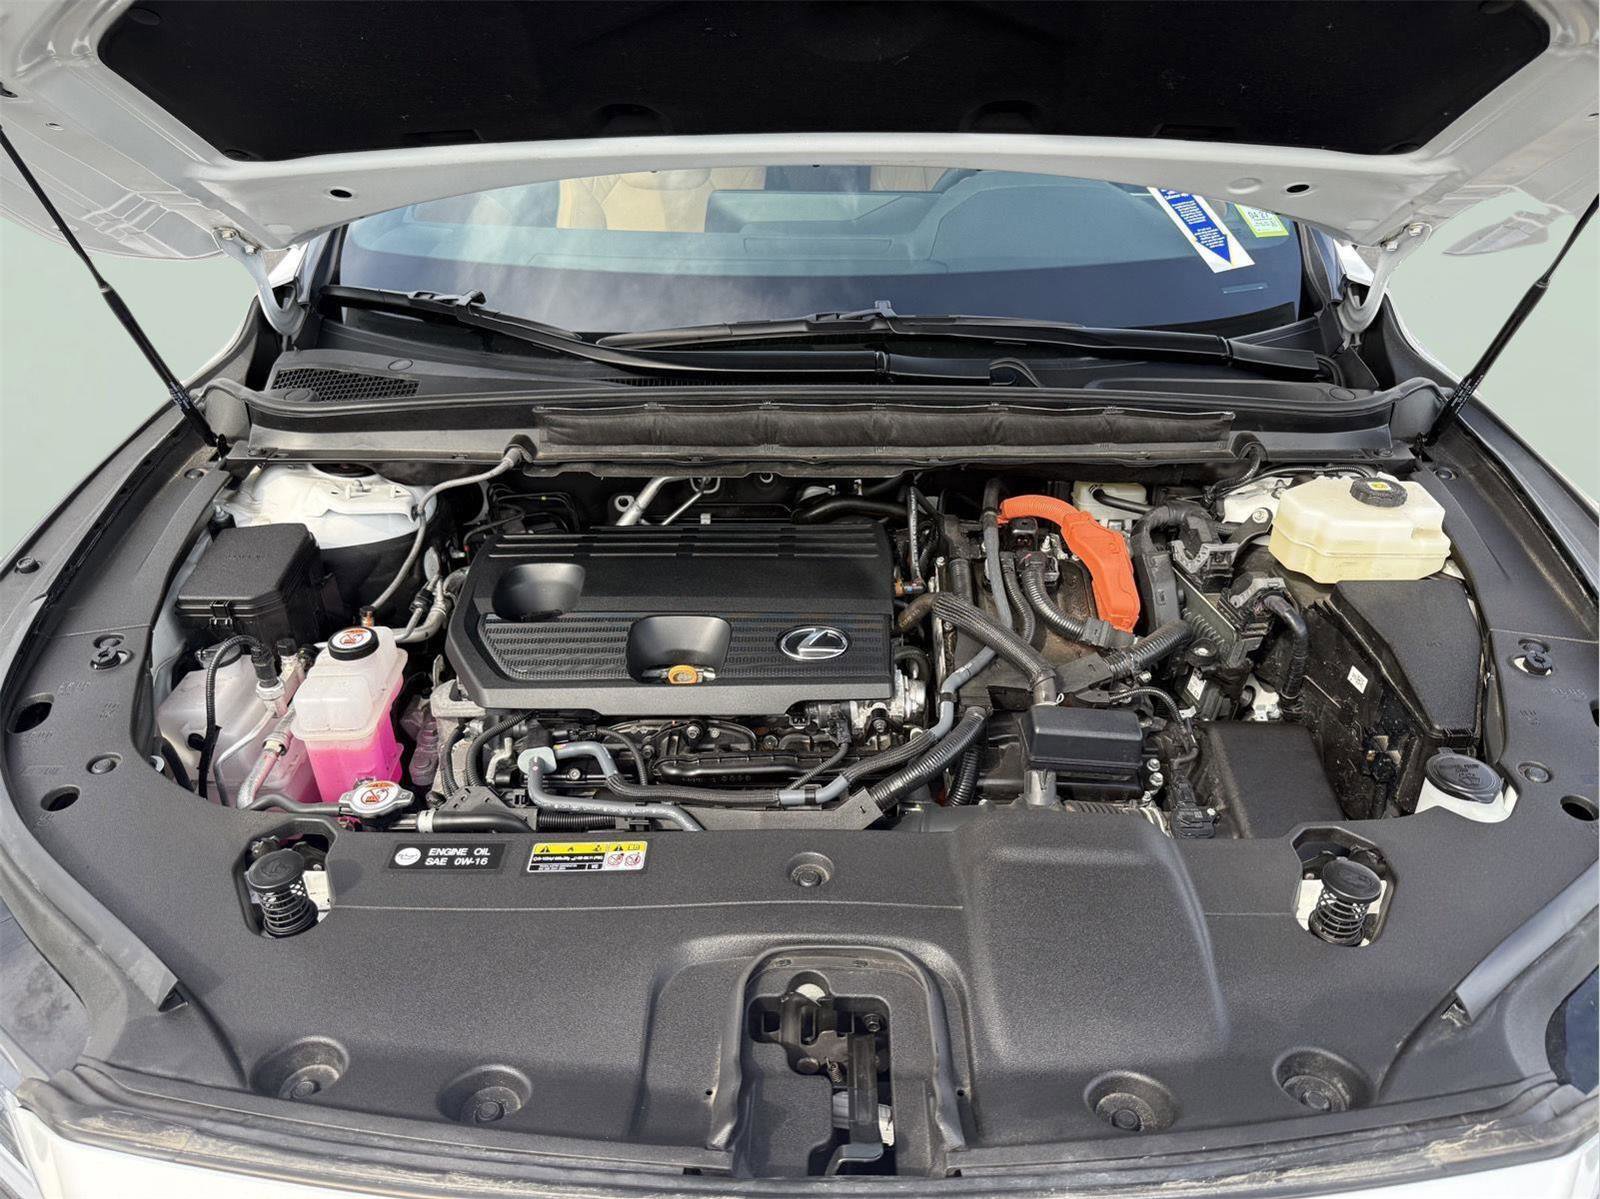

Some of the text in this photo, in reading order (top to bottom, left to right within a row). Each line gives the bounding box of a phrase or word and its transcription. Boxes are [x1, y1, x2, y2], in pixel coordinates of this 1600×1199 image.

[428, 847, 491, 856] ENGINE OIL
[424, 857, 488, 866] SAE 0W-16
